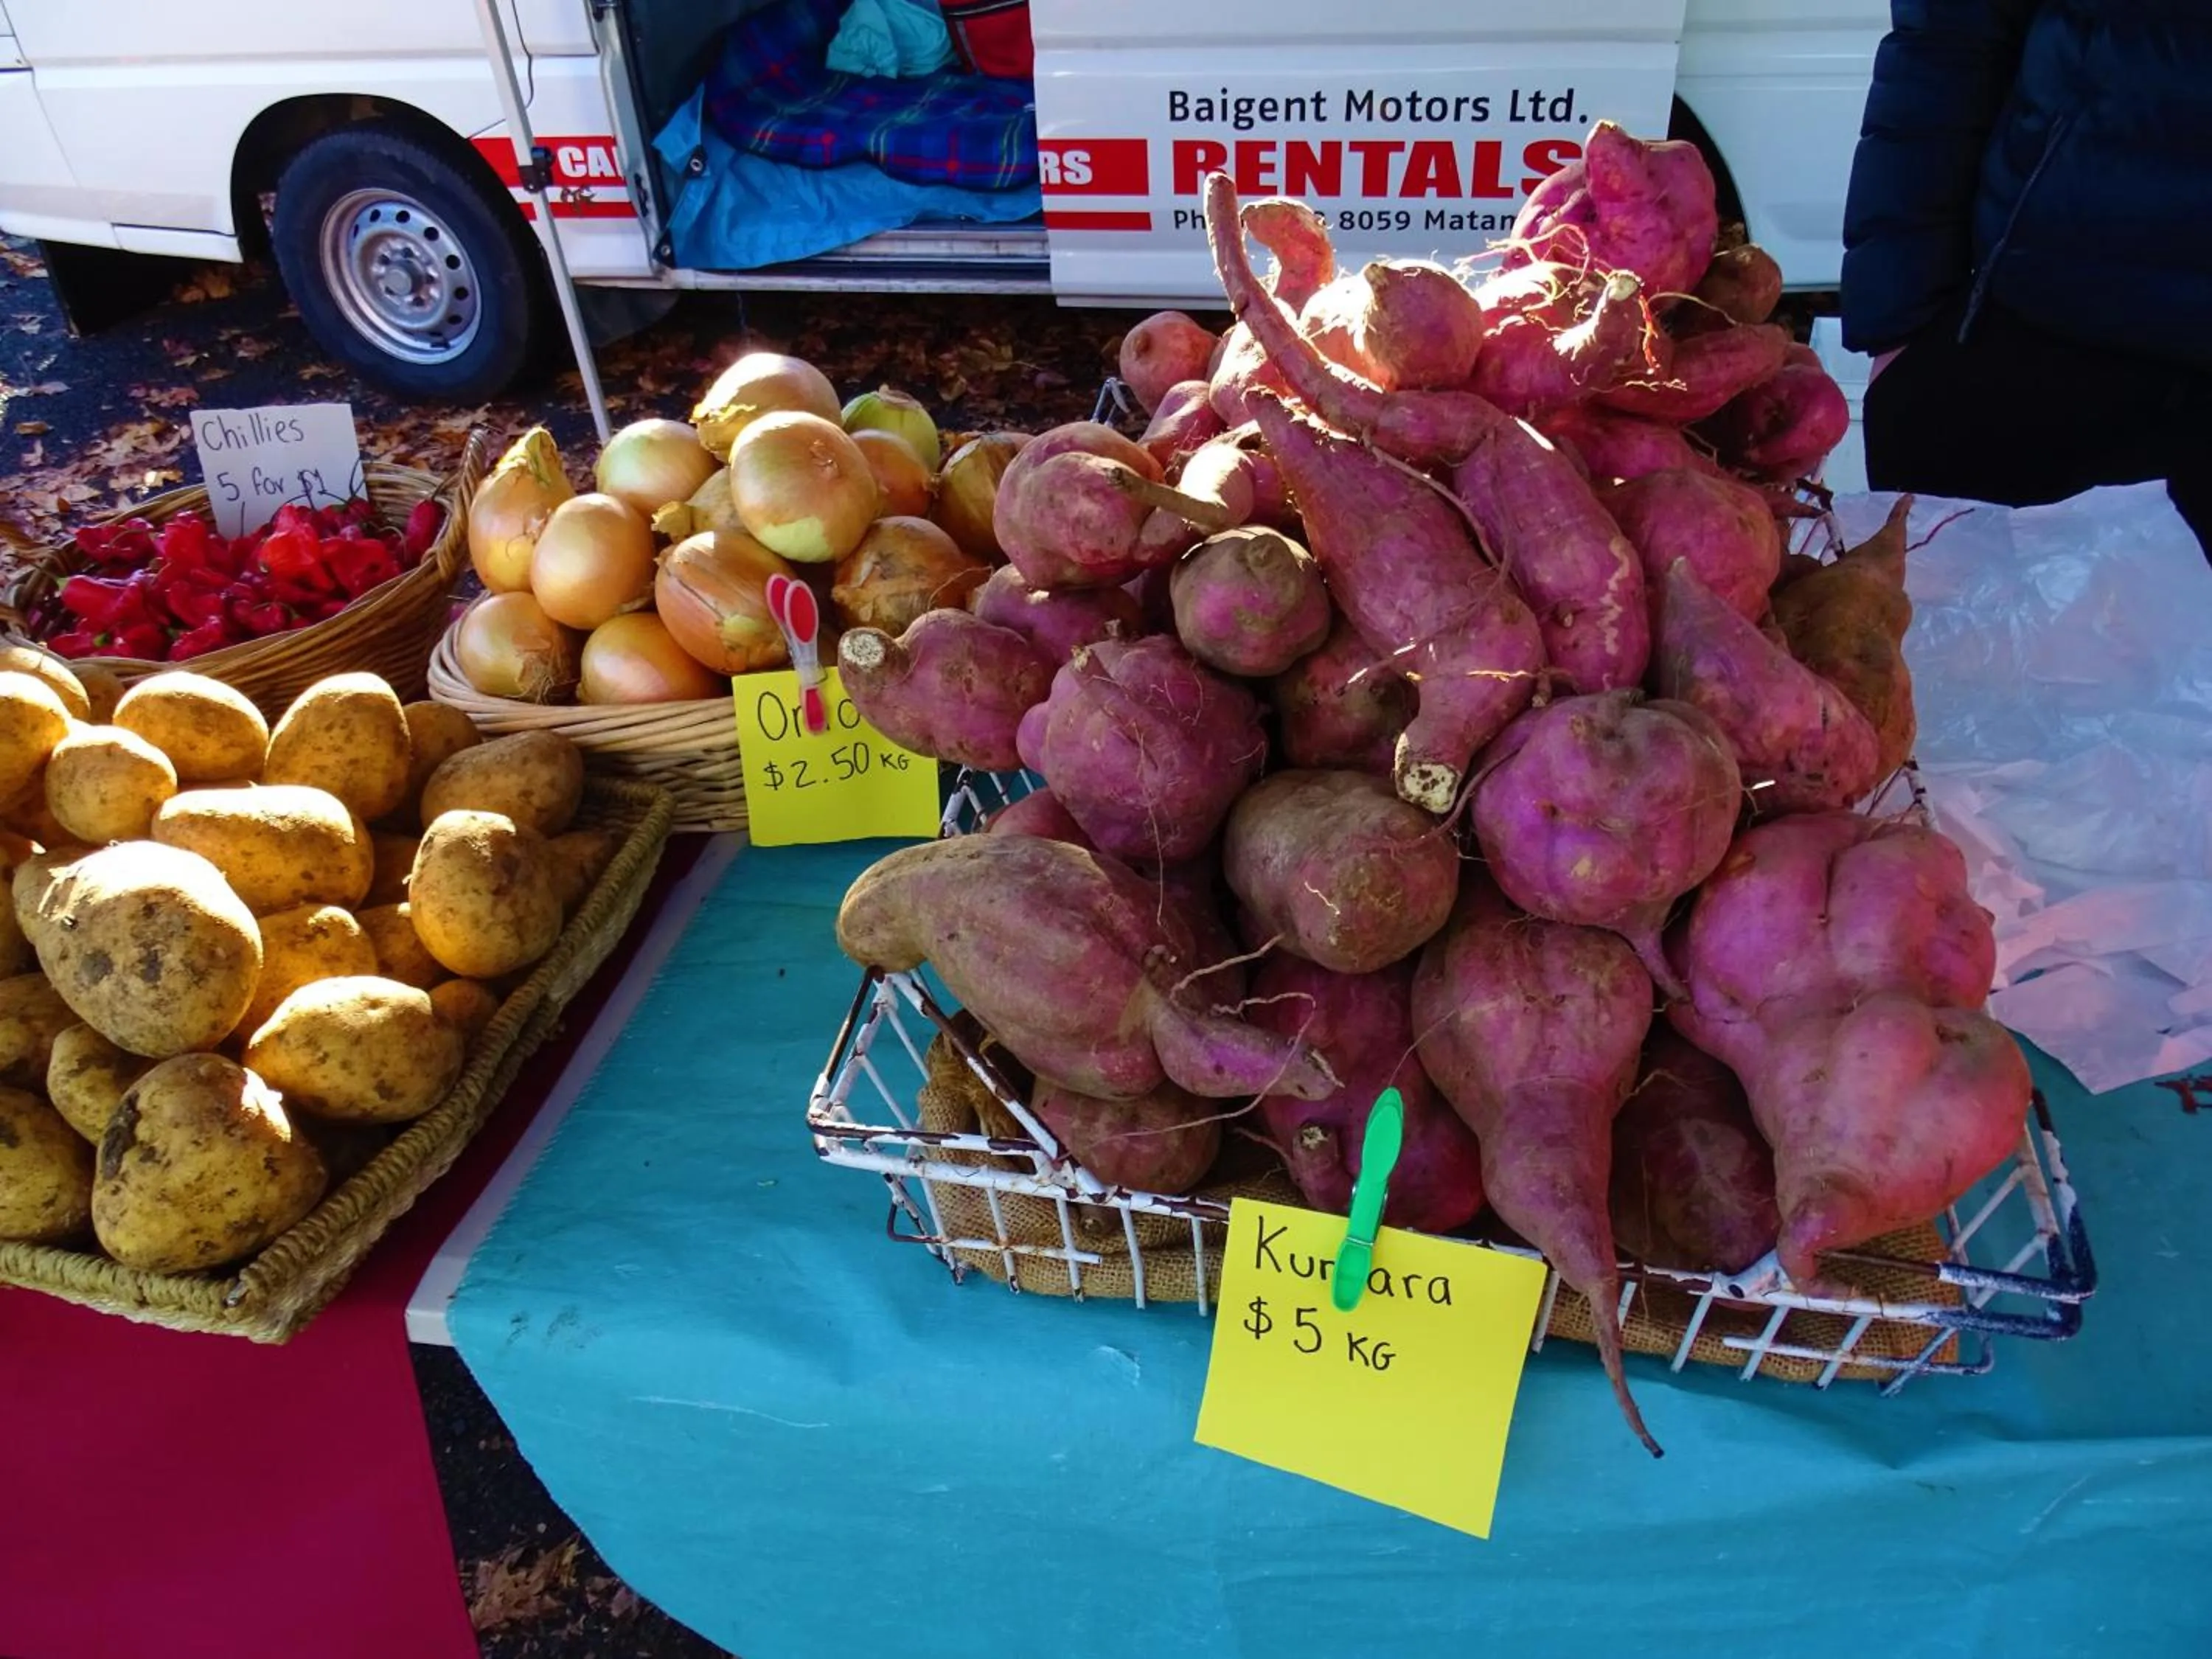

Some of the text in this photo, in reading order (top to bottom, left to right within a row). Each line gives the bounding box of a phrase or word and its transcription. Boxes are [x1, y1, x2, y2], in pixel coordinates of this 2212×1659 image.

[1169, 88, 1587, 130] Baigent Motors Ltd.
[557, 146, 626, 178] CA
[1173, 139, 1582, 199] RENTALS
[1339, 210, 1411, 231] 8059
[202, 413, 305, 451] Chillies
[217, 472, 240, 501] 5
[251, 467, 285, 495] for
[880, 753, 910, 771] KG
[1347, 1332, 1396, 1371] KG
